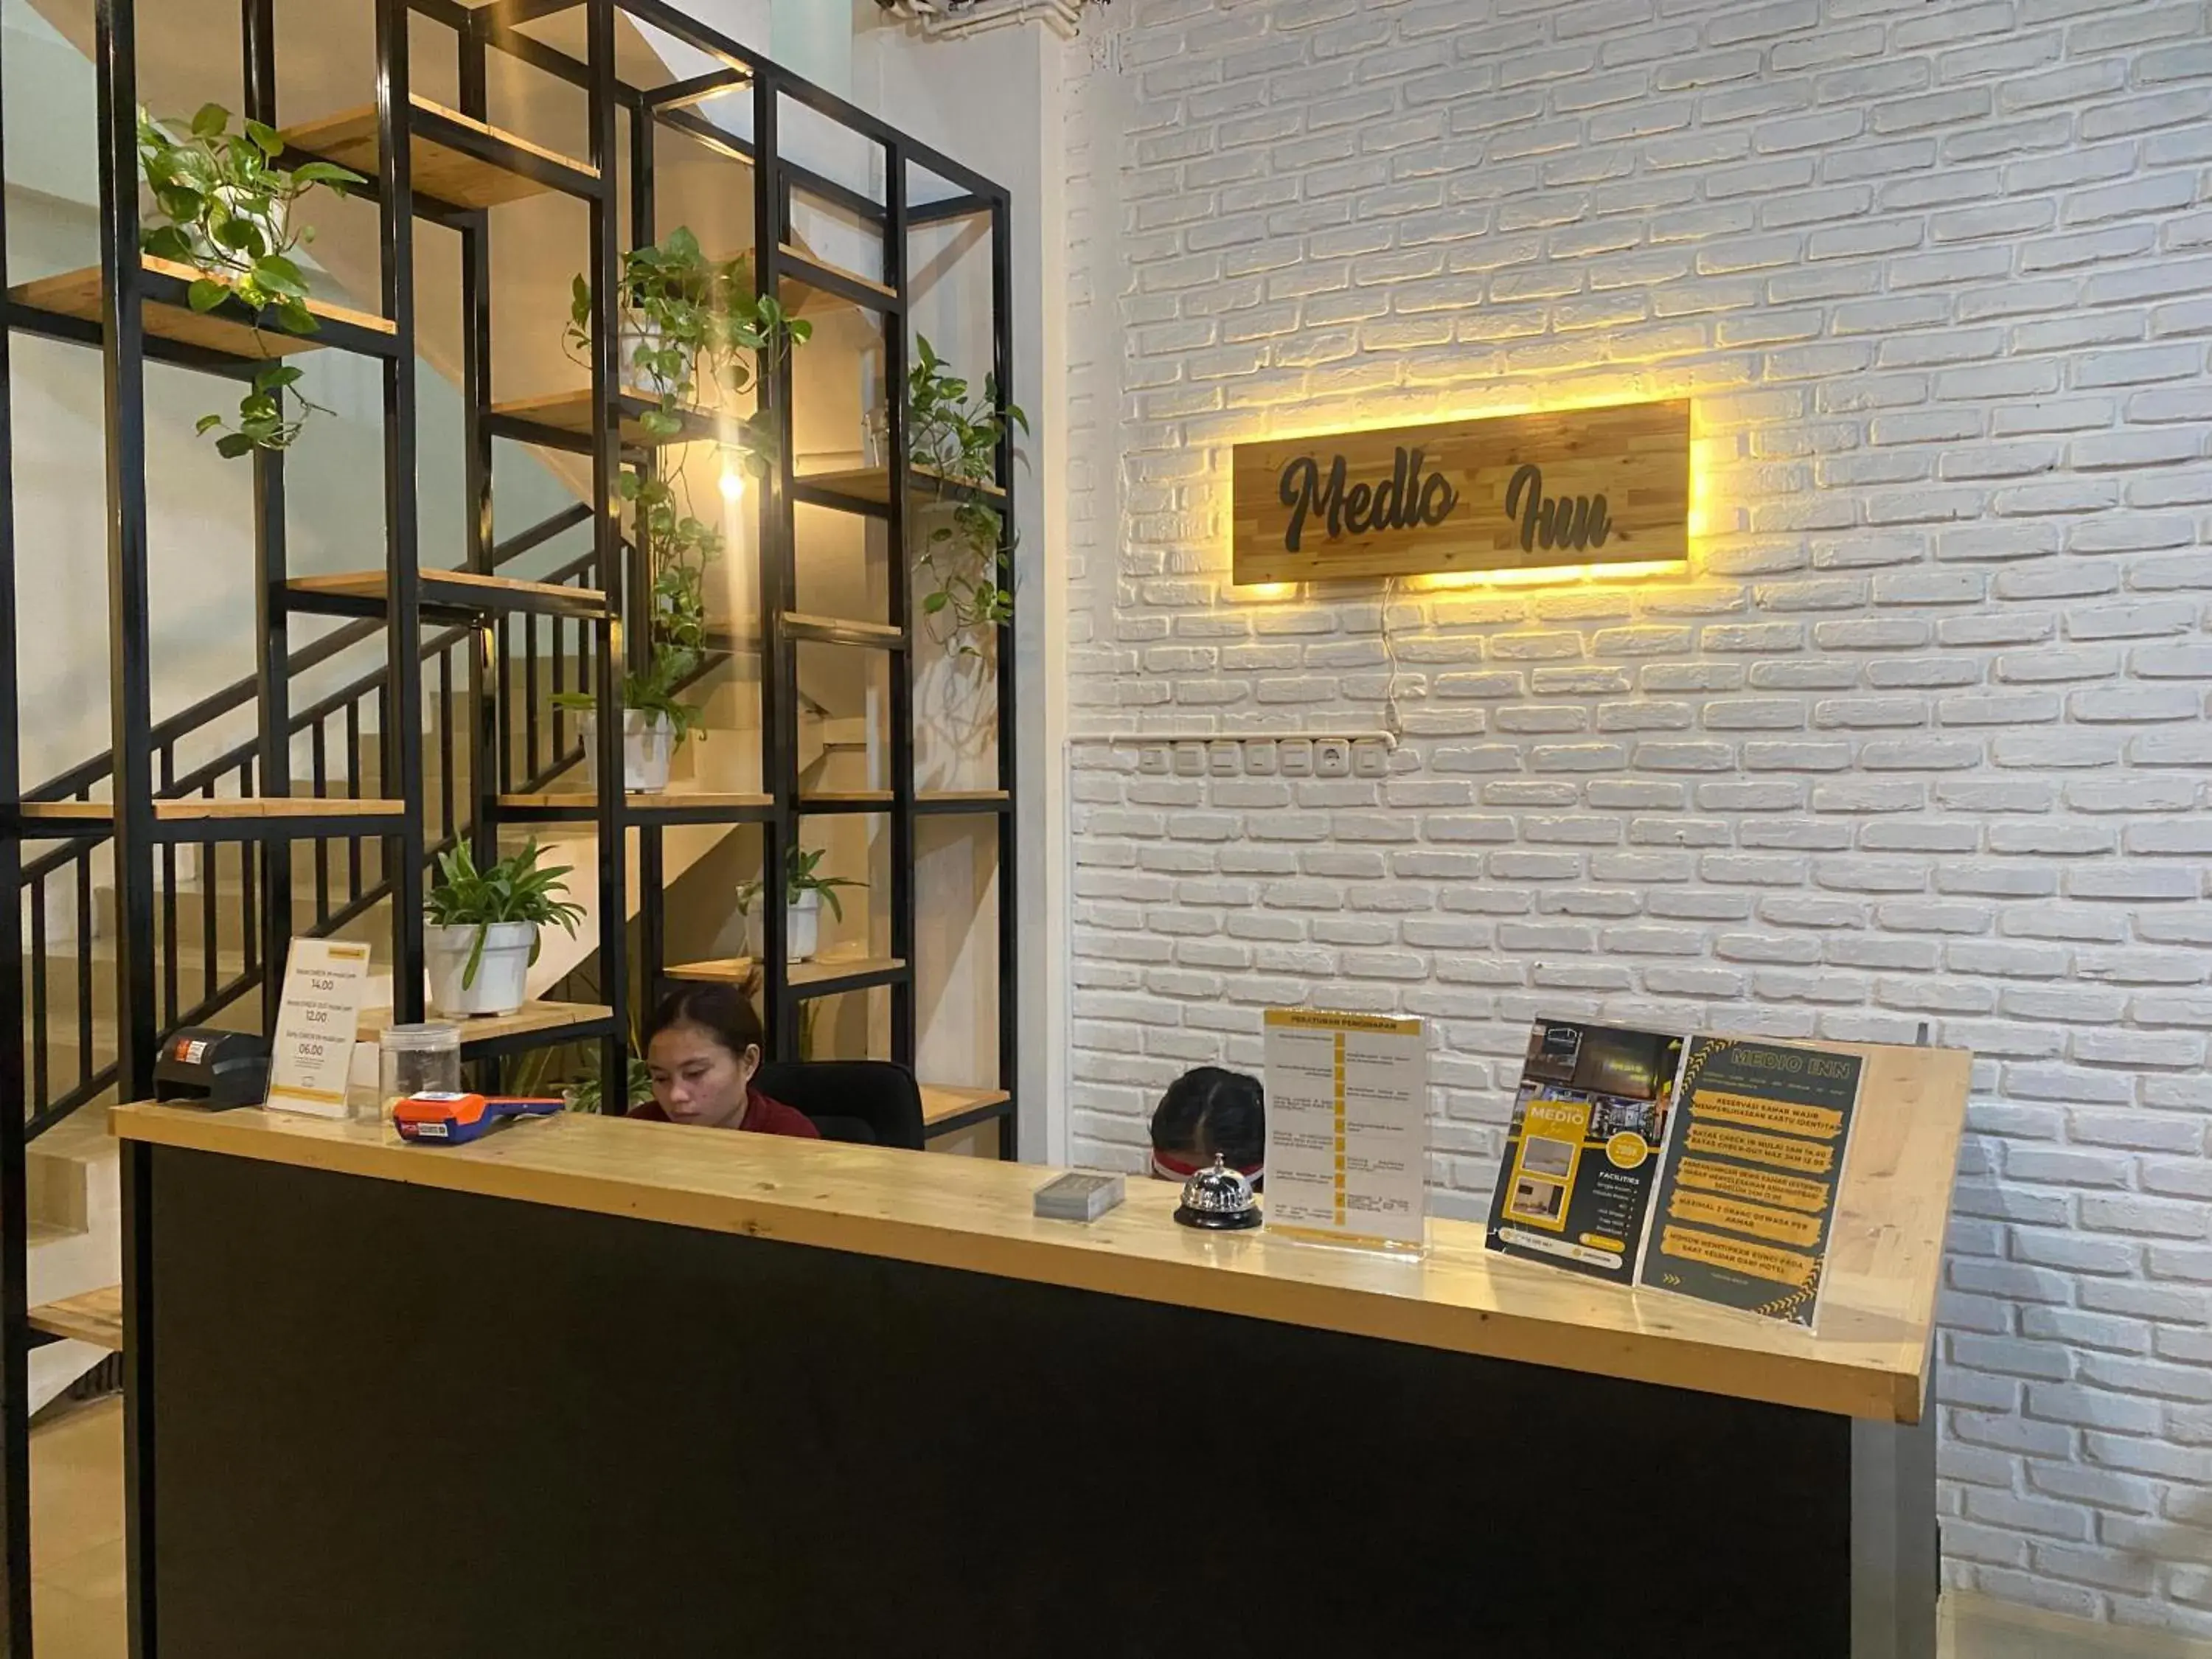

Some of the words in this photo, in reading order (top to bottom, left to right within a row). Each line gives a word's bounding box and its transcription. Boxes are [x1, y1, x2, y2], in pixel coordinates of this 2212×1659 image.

[1506, 463, 1612, 552] Inn
[311, 978, 333, 990] 14.00
[306, 1009, 327, 1022] 12.00
[299, 1043, 323, 1055] 06.00
[1731, 1048, 1804, 1073] MEDIO
[1807, 1058, 1851, 1080] INN
[1716, 1098, 1759, 1110] RESERVASI
[1531, 1107, 1585, 1125] MEDIO
[1691, 1137, 1716, 1147] BATAS
[1692, 1130, 1717, 1140] BATAS
[1719, 1133, 1745, 1144] CHECK
[1758, 1139, 1784, 1150] MULAI
[1599, 1171, 1640, 1185] FACILITIES
[1753, 1213, 1789, 1225] DEWASA
[1791, 1220, 1809, 1231] PER
[1759, 1262, 1785, 1274] HOTEL
